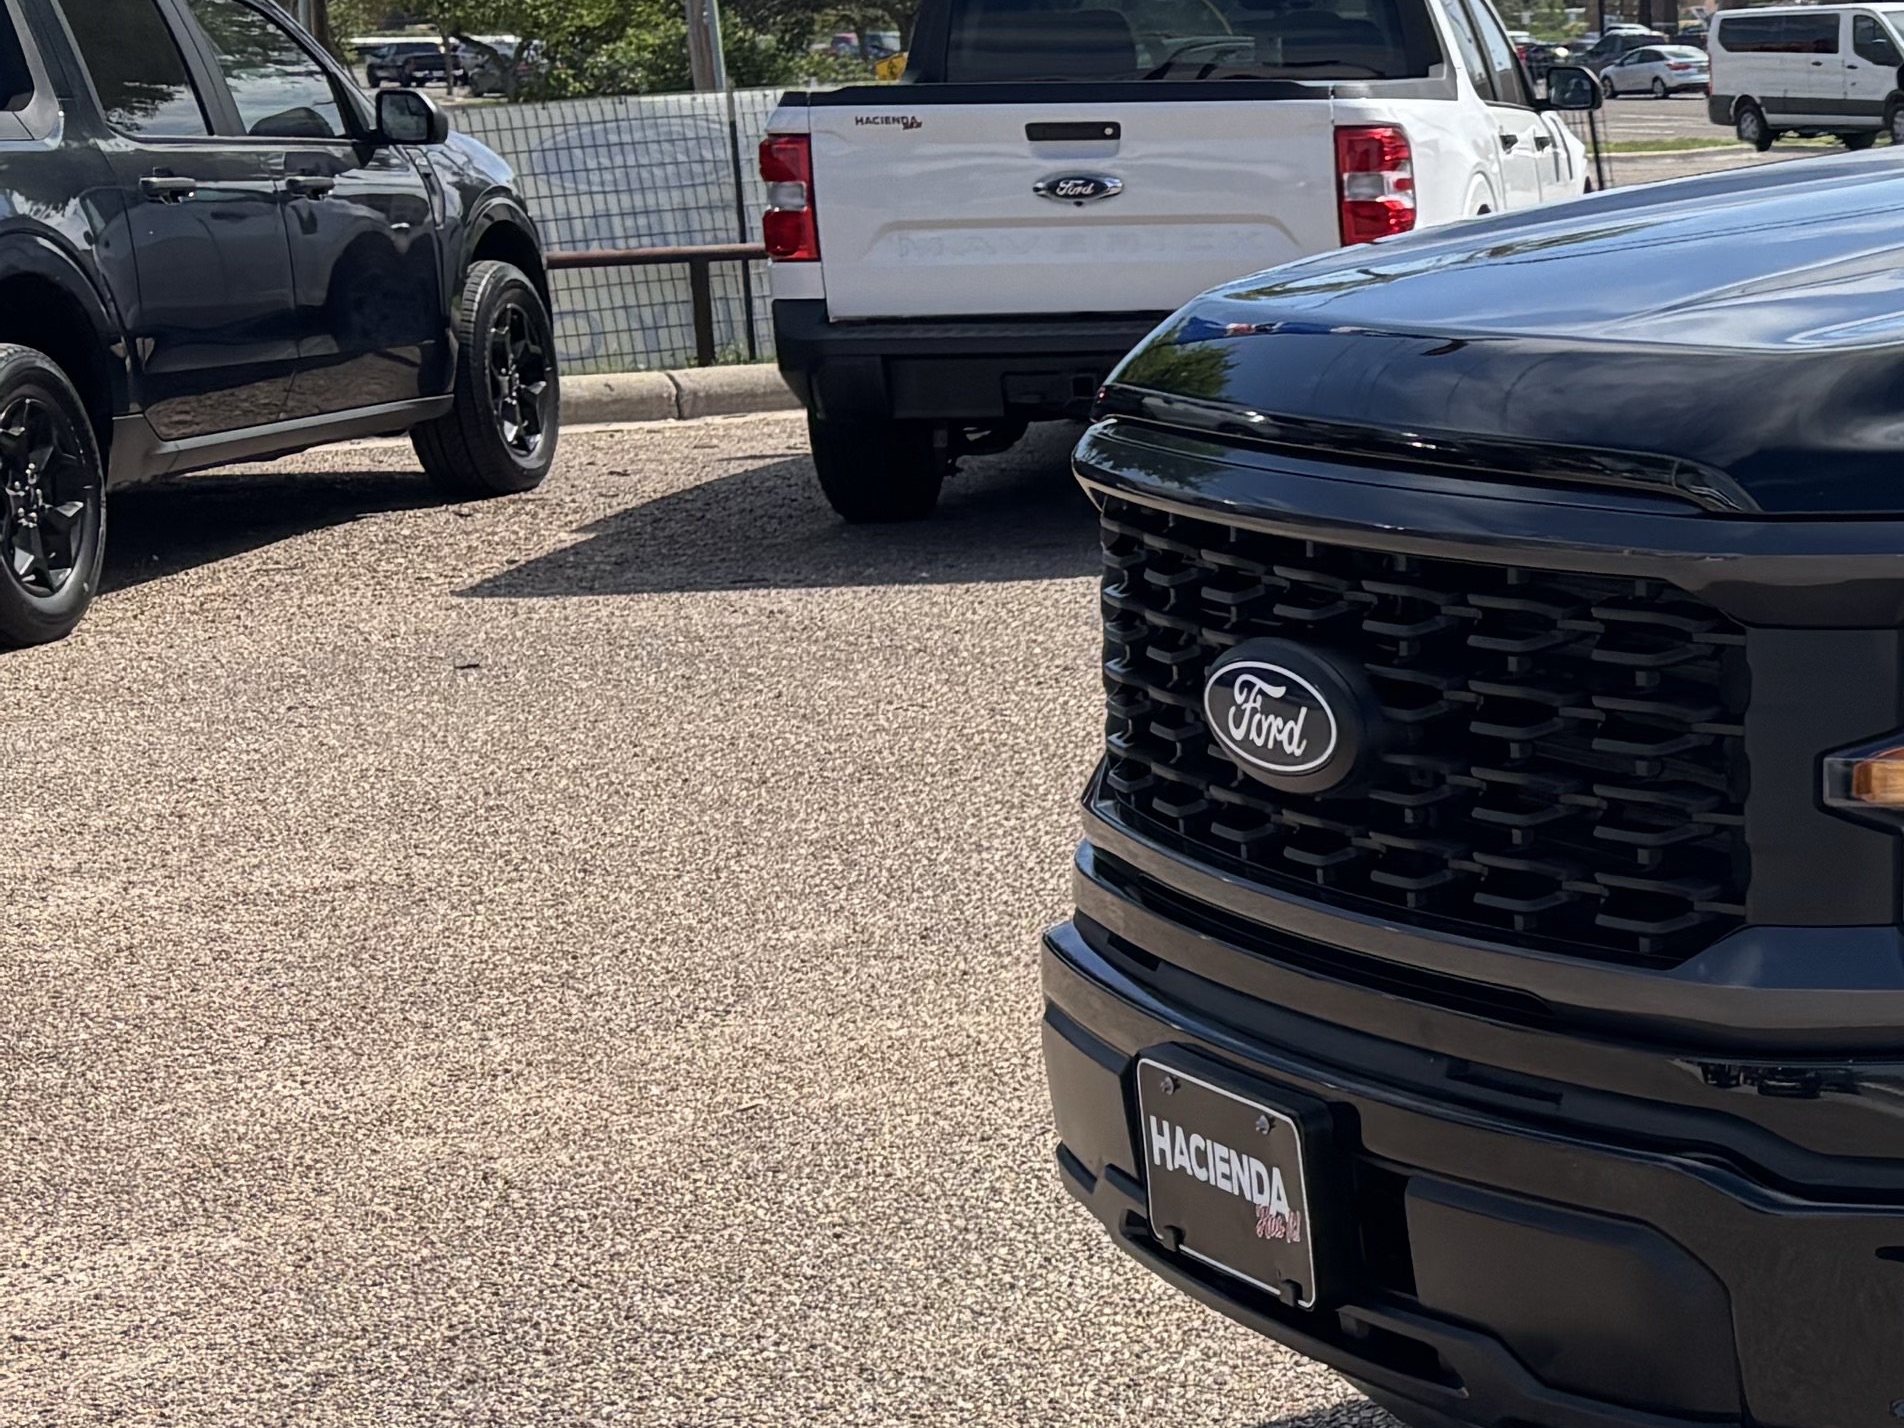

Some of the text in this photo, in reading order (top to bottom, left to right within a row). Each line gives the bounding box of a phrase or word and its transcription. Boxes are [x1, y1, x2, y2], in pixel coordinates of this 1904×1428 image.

[854, 115, 919, 126] HACIENDA
[1055, 178, 1095, 197] Ford
[1227, 673, 1308, 757] Ford
[1149, 1114, 1291, 1222] HACIENDA
